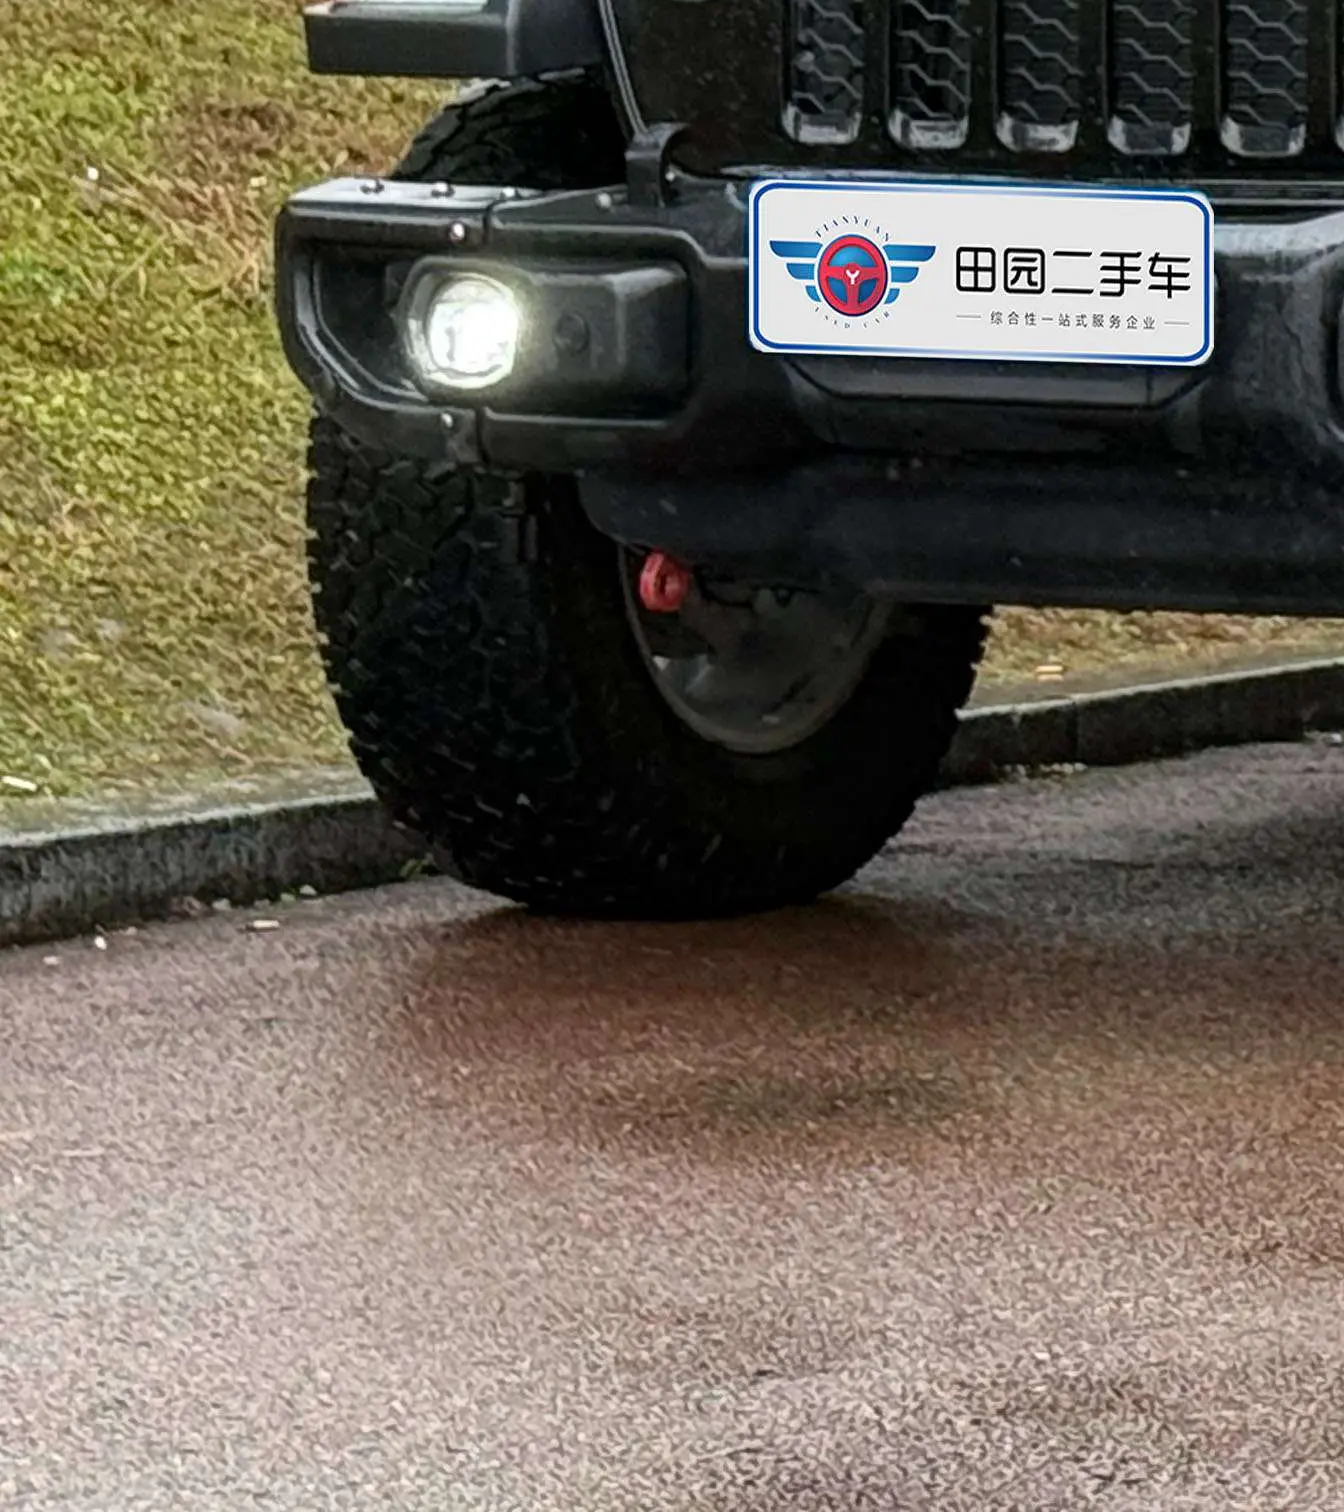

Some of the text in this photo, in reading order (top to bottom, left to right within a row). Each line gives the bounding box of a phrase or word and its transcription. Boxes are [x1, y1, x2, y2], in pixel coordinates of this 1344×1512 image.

[955, 245, 1192, 300] 田园二手车
[990, 310, 1156, 331] 综合性一站式服务企业
